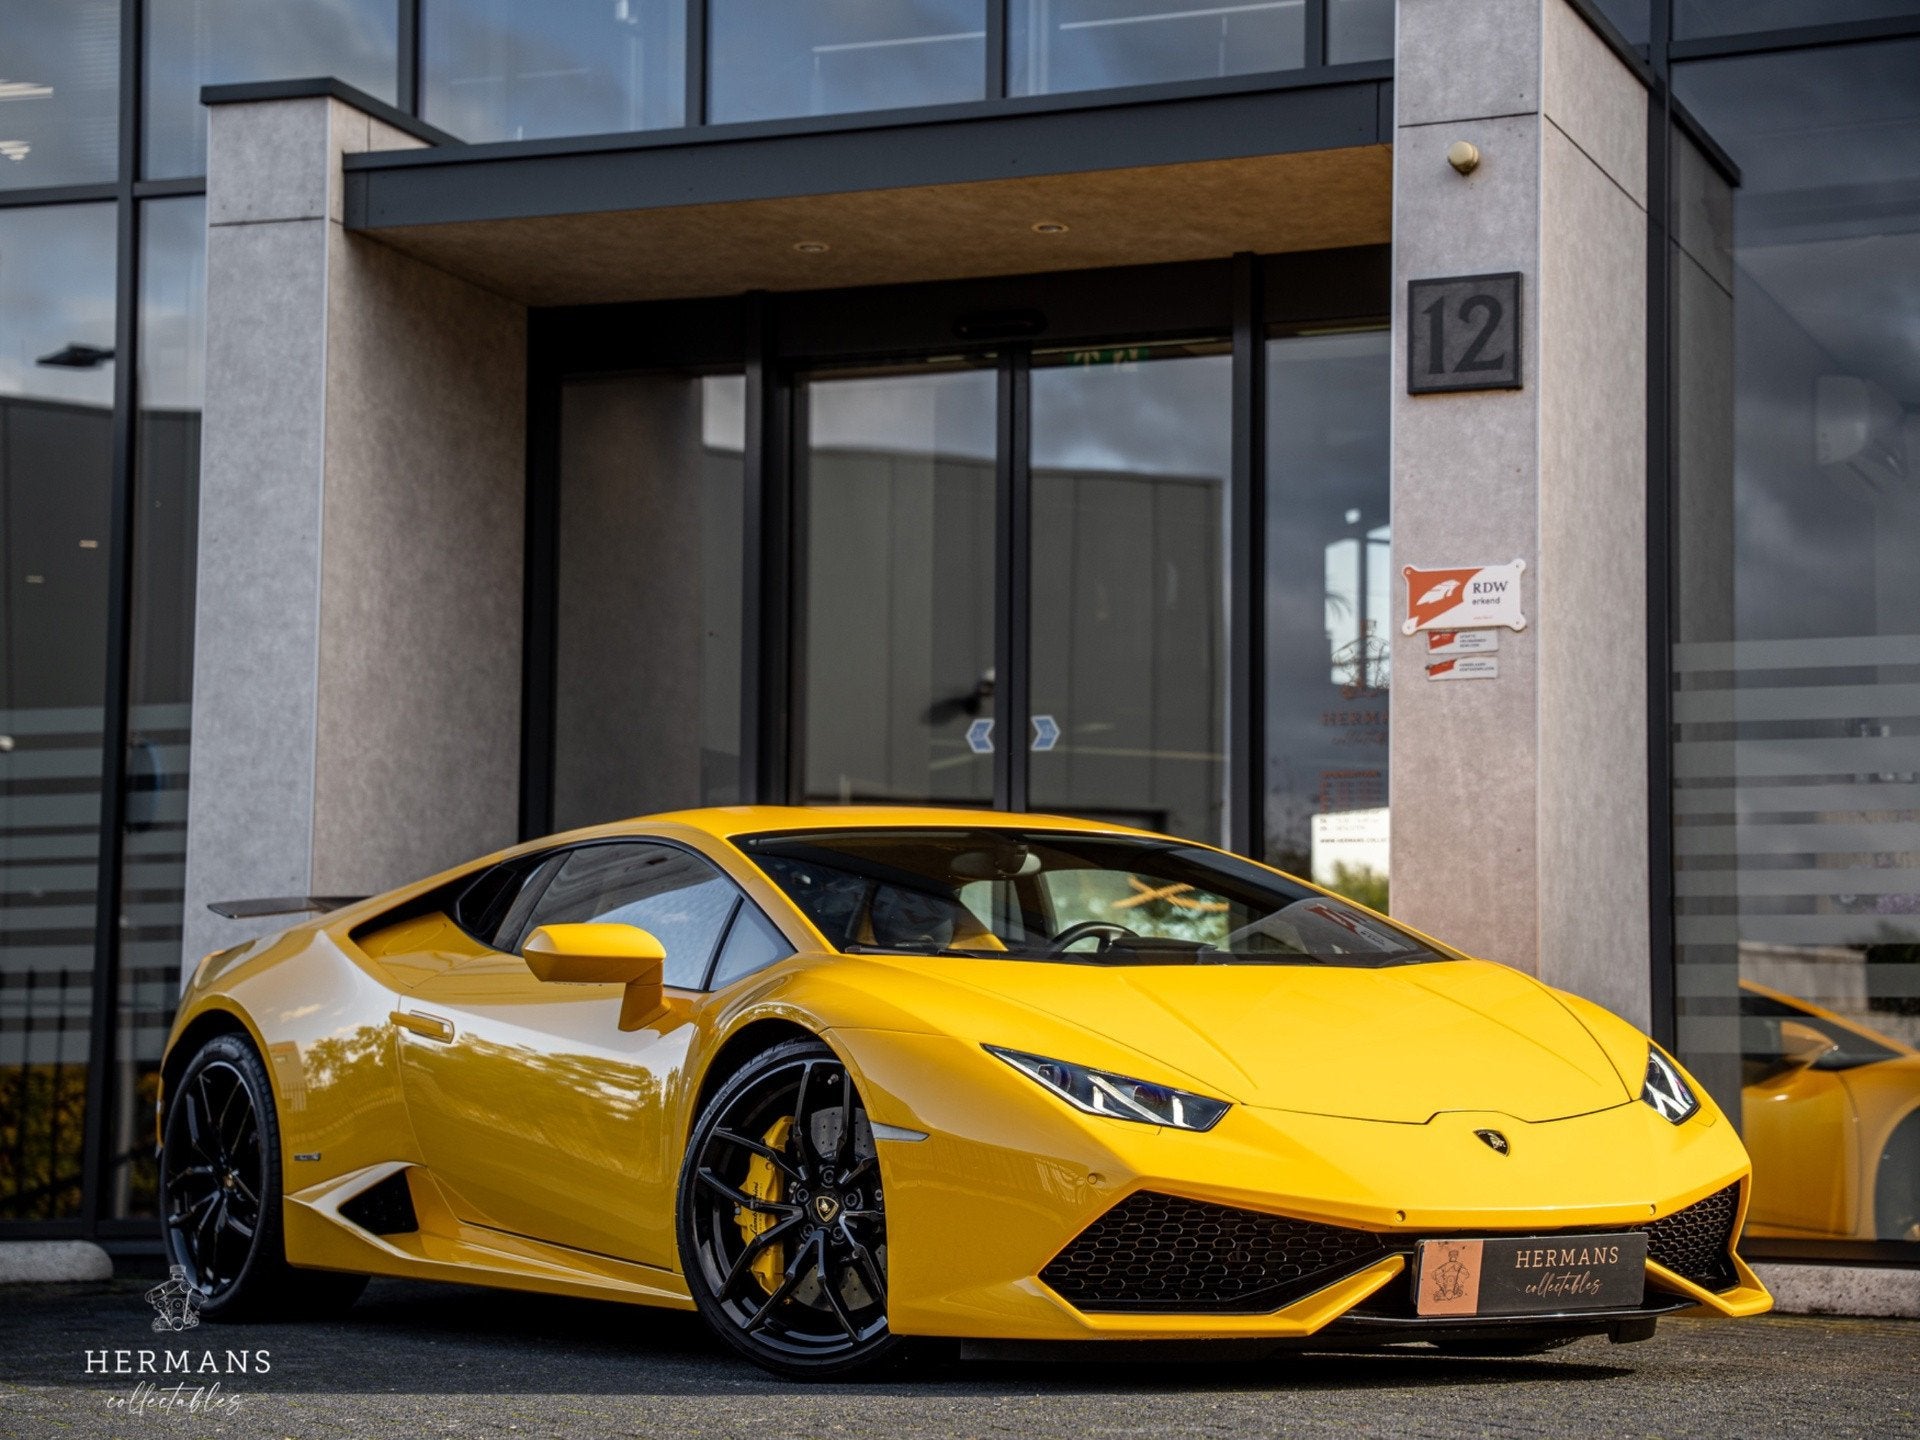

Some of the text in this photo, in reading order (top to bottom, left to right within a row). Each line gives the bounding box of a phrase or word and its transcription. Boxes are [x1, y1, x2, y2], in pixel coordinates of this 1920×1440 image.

[1422, 294, 1505, 375] 12
[1473, 580, 1508, 594] RDW
[1472, 597, 1501, 606] erkend
[1515, 1246, 1619, 1269] HERMANS
[1525, 1271, 1602, 1298] collectables
